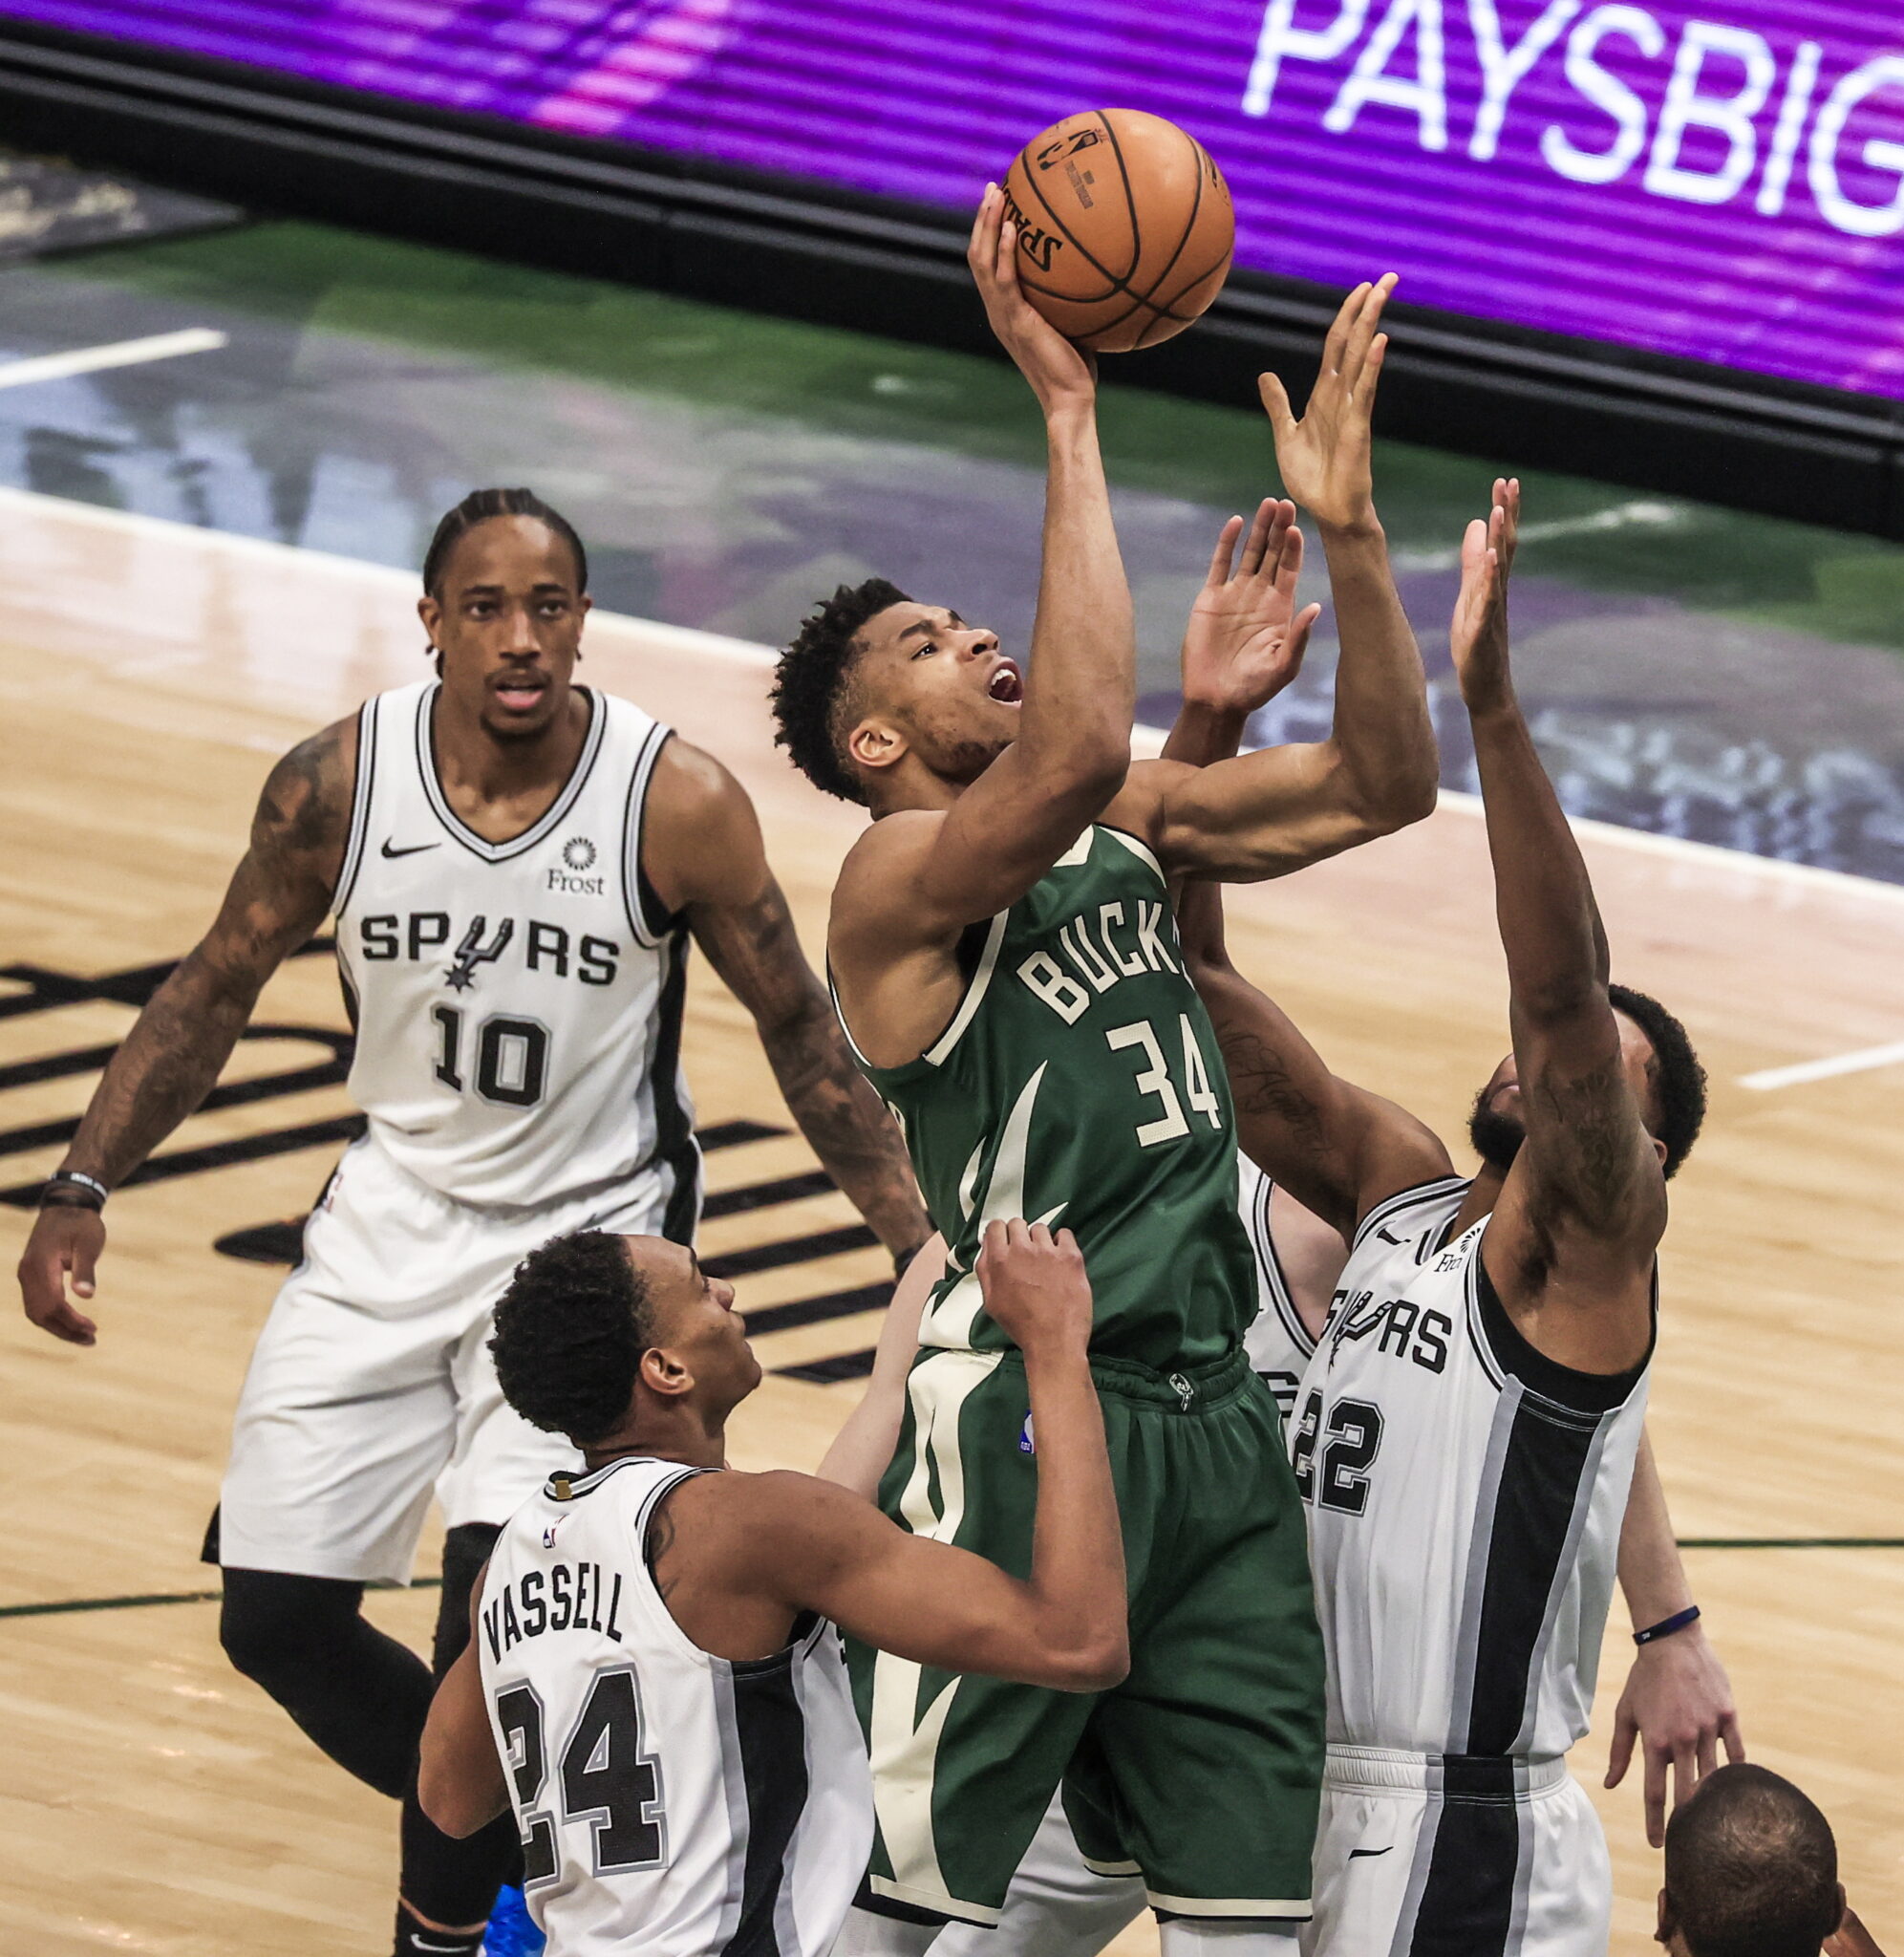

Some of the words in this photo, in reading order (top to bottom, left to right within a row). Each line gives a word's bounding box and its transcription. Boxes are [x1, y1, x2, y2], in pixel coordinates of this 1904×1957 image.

[547, 867, 605, 896] Frost
[360, 912, 620, 994] SPURS
[1016, 899, 1195, 1027] BUCK
[430, 1001, 553, 1111] 10
[1104, 1012, 1223, 1149] 34
[1319, 1289, 1453, 1375] SURS
[1292, 1387, 1385, 1518] 22
[482, 1561, 623, 1666] VASSELL
[494, 1662, 670, 1894] 24
